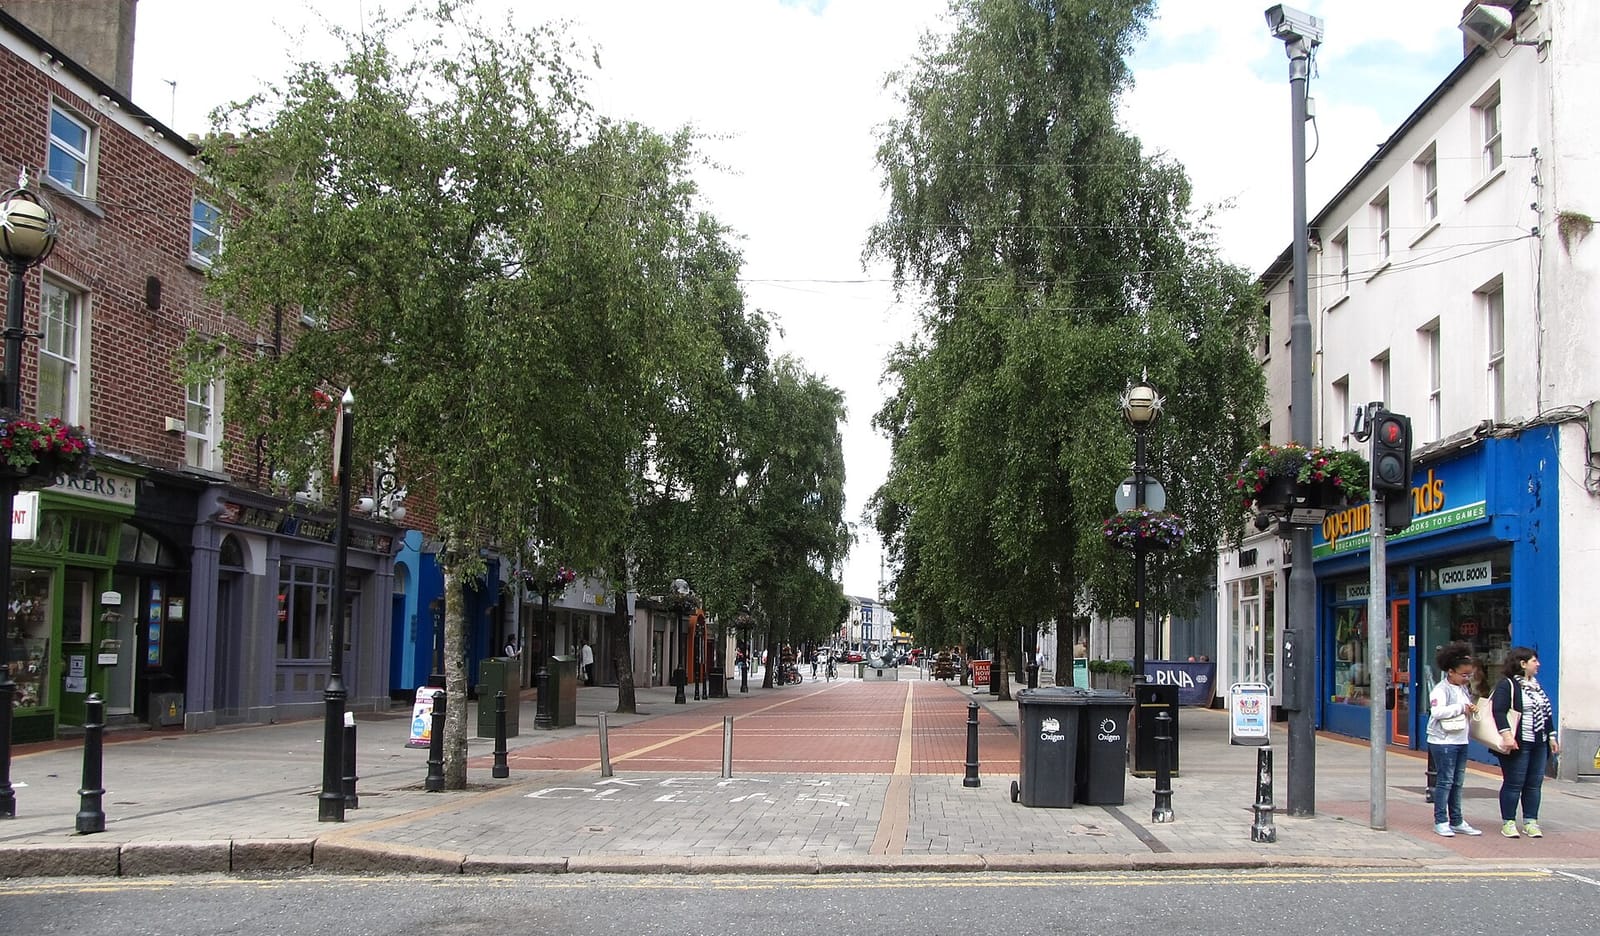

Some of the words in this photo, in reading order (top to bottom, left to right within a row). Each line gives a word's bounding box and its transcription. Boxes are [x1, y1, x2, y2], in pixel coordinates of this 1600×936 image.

[1433, 514, 1453, 526] TOYS
[1456, 507, 1485, 520] GAMES
[1323, 504, 1371, 550] openin
[1442, 569, 1465, 584] SCHOOL
[1466, 566, 1488, 581] BOOKS
[1156, 669, 1195, 688] RIVA
[1040, 733, 1065, 743] Oxigen
[1097, 733, 1121, 743] Oxigen
